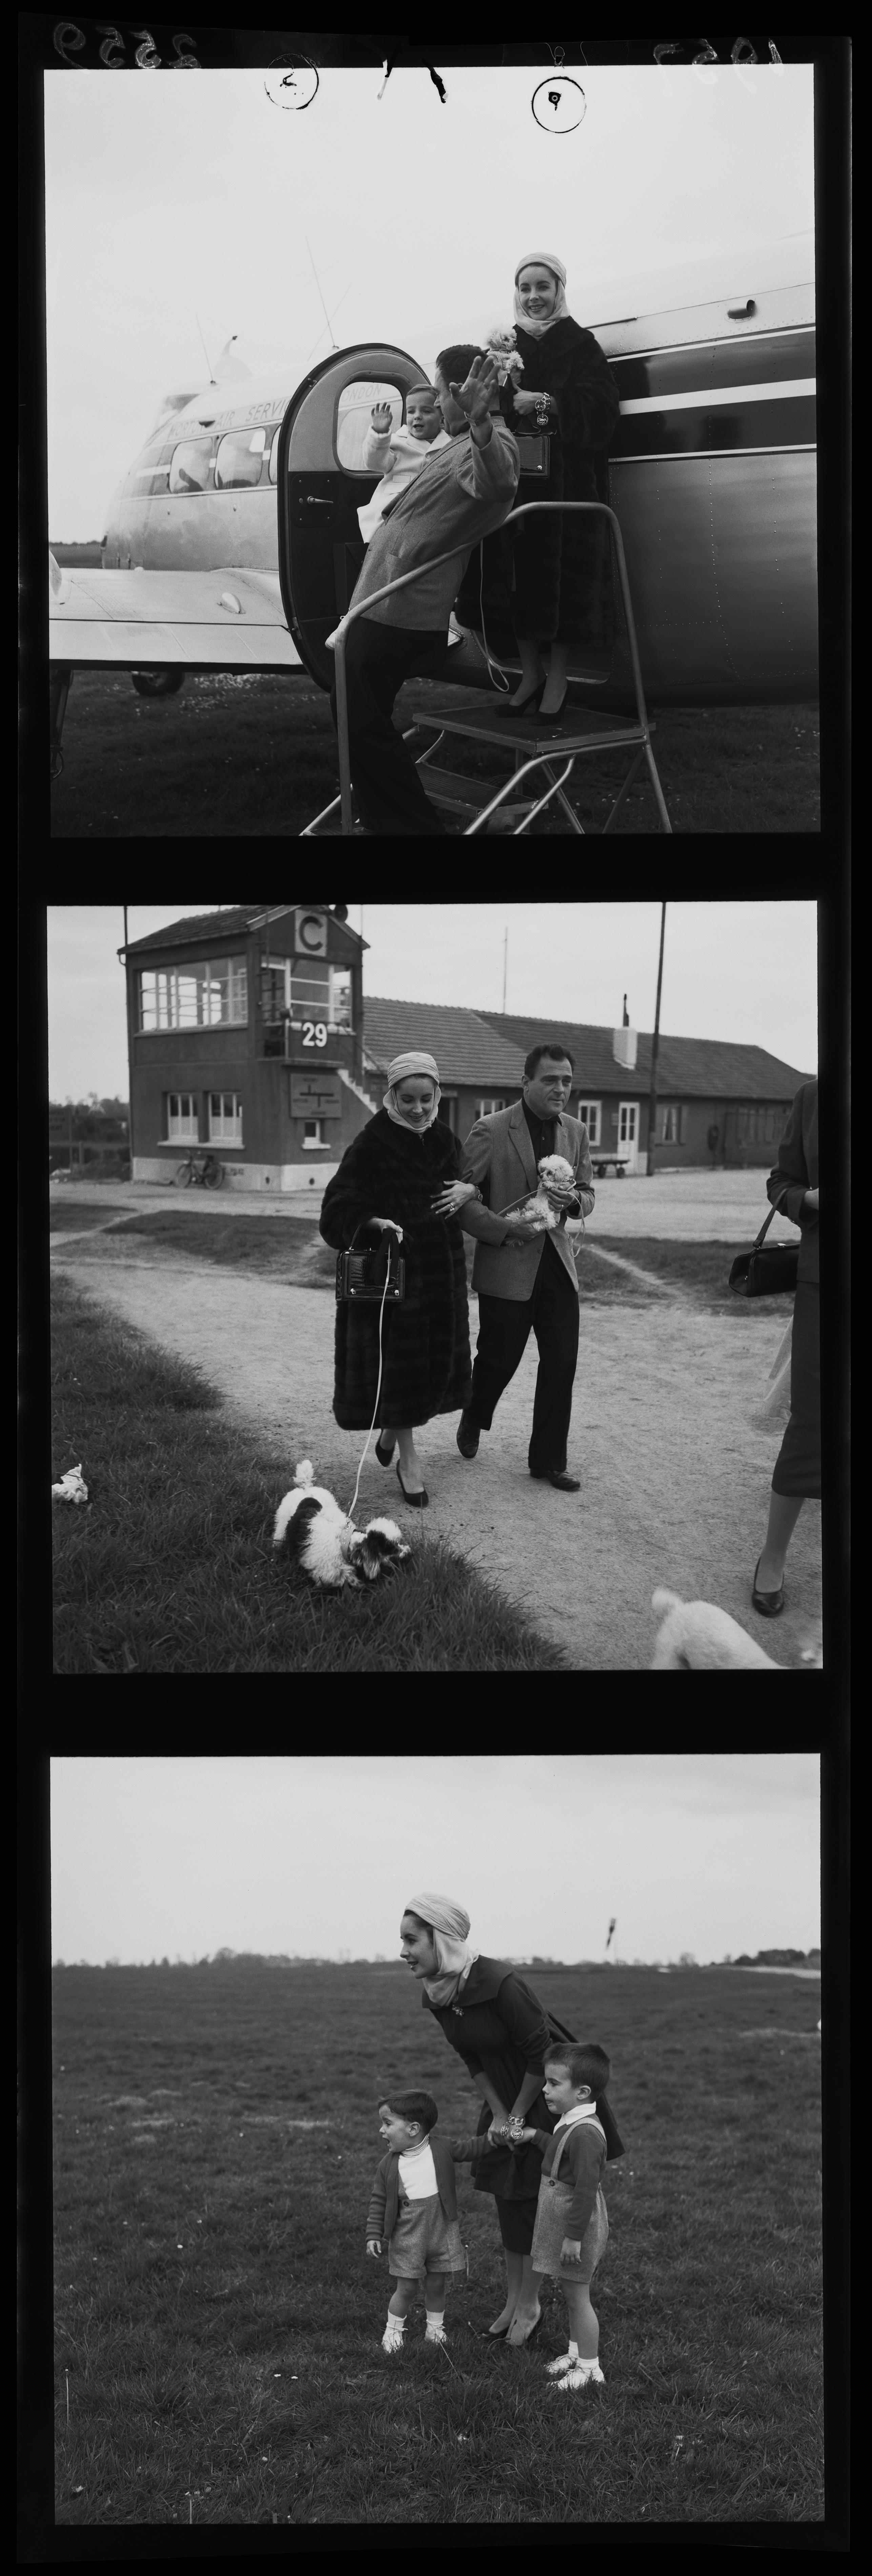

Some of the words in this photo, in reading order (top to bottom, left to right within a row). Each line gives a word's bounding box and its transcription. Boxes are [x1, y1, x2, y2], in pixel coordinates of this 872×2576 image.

[215, 411, 235, 428] AIR
[342, 383, 383, 402] ONDON
[299, 916, 323, 951] C
[302, 1022, 327, 1047] 29
